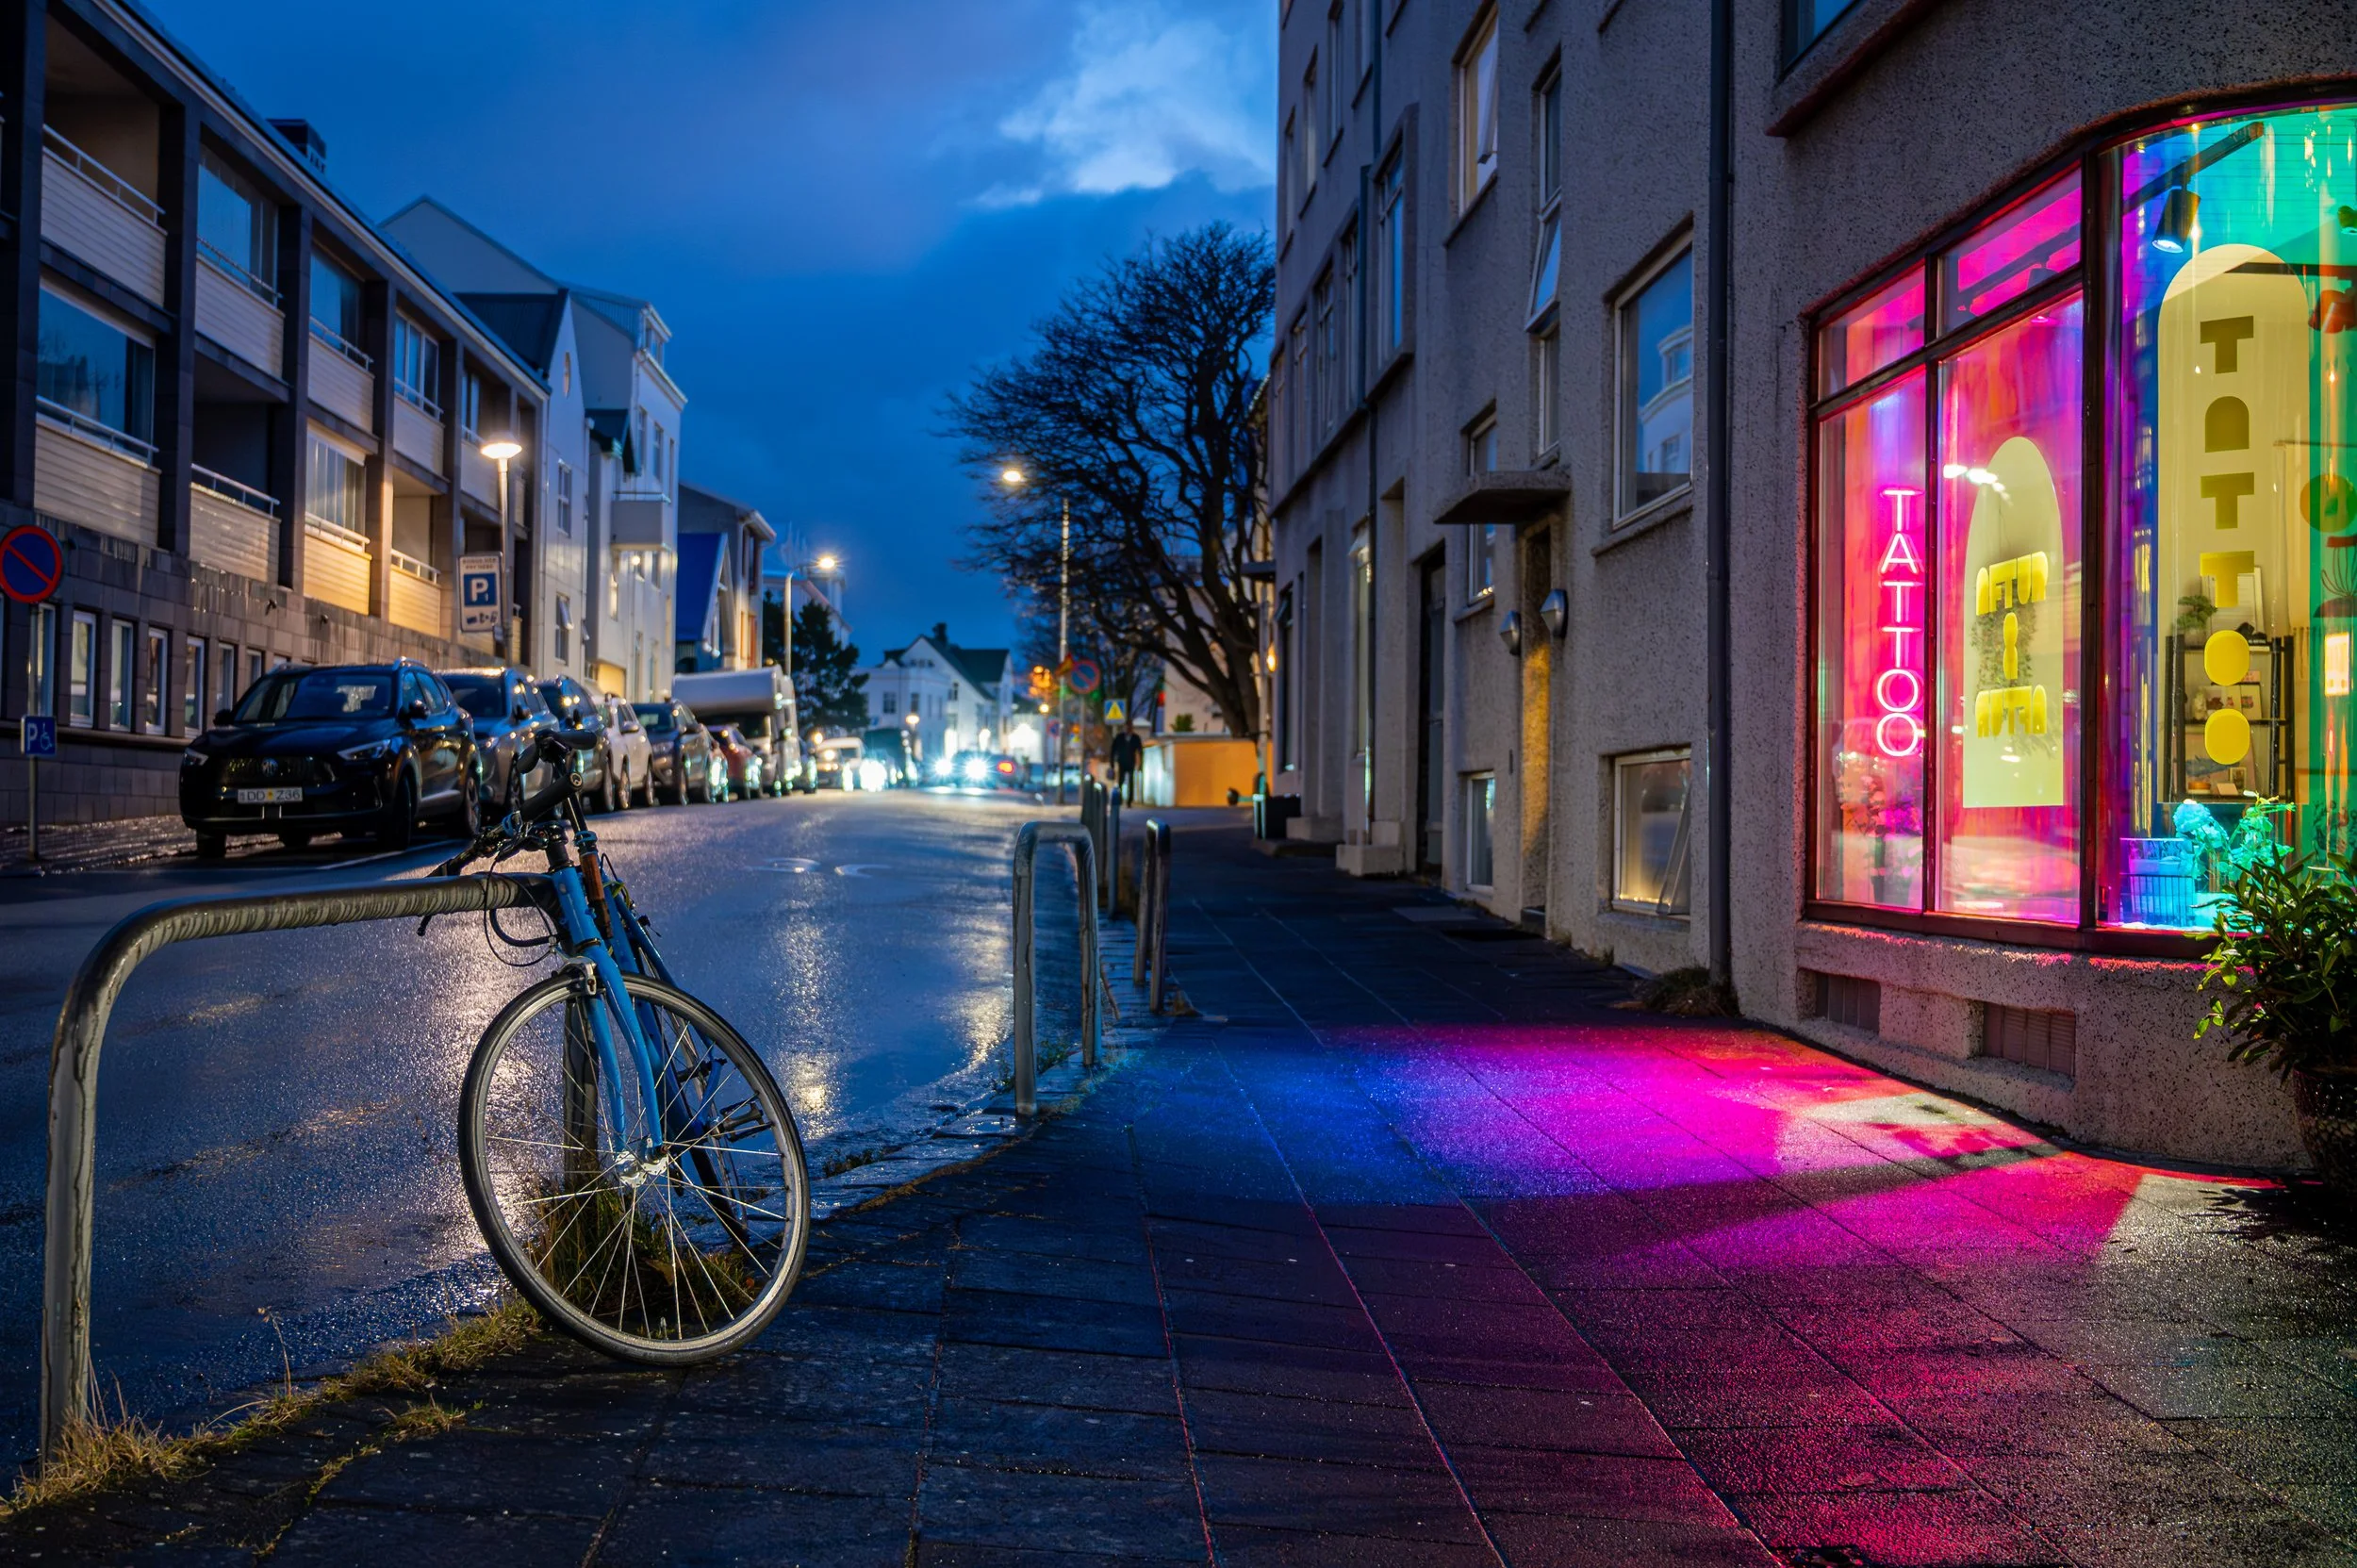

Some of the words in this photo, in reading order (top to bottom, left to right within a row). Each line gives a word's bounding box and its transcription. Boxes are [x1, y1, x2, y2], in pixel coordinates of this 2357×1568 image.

[1876, 488, 1919, 757] TATTOO
[2200, 316, 2254, 765] TATTOO
[27, 722, 39, 751] P
